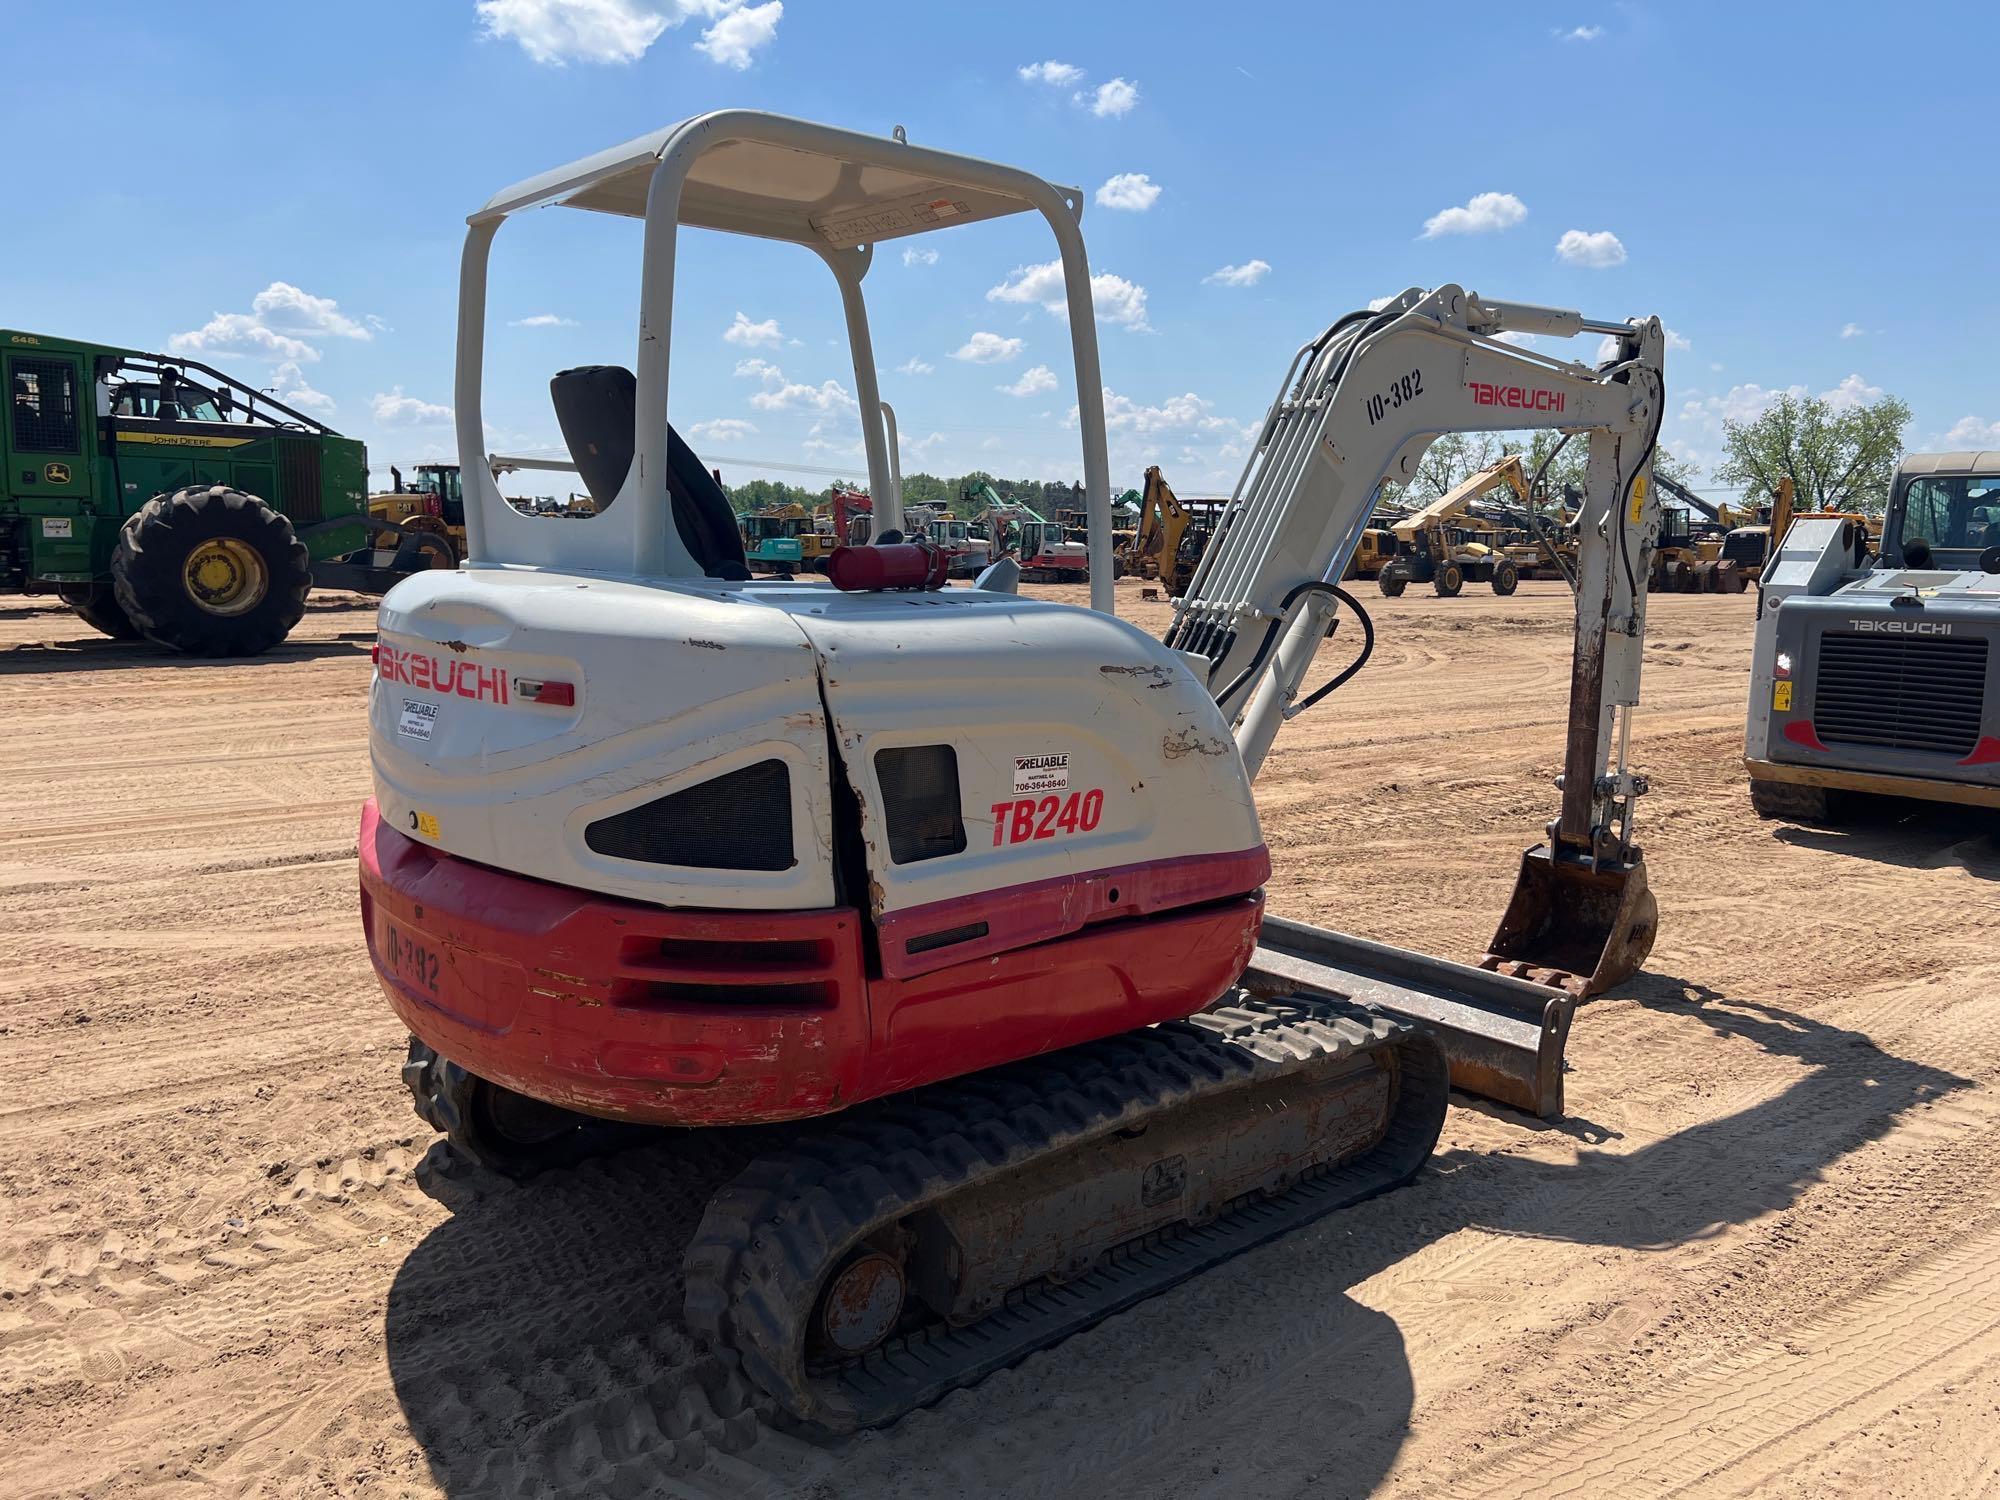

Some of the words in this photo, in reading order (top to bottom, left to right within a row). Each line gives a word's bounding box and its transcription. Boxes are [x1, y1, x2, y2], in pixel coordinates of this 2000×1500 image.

[12, 336, 41, 345] 648L
[1367, 369, 1424, 426] 10-382
[1469, 382, 1565, 412] TAKEUCHI
[152, 435, 177, 444] JOHN
[180, 437, 212, 445] DEERE
[1849, 620, 1952, 635] TAKEUCHI
[408, 702, 438, 718] RELIABLE
[1023, 755, 1068, 770] RELIABLE
[990, 788, 1104, 847] TB240
